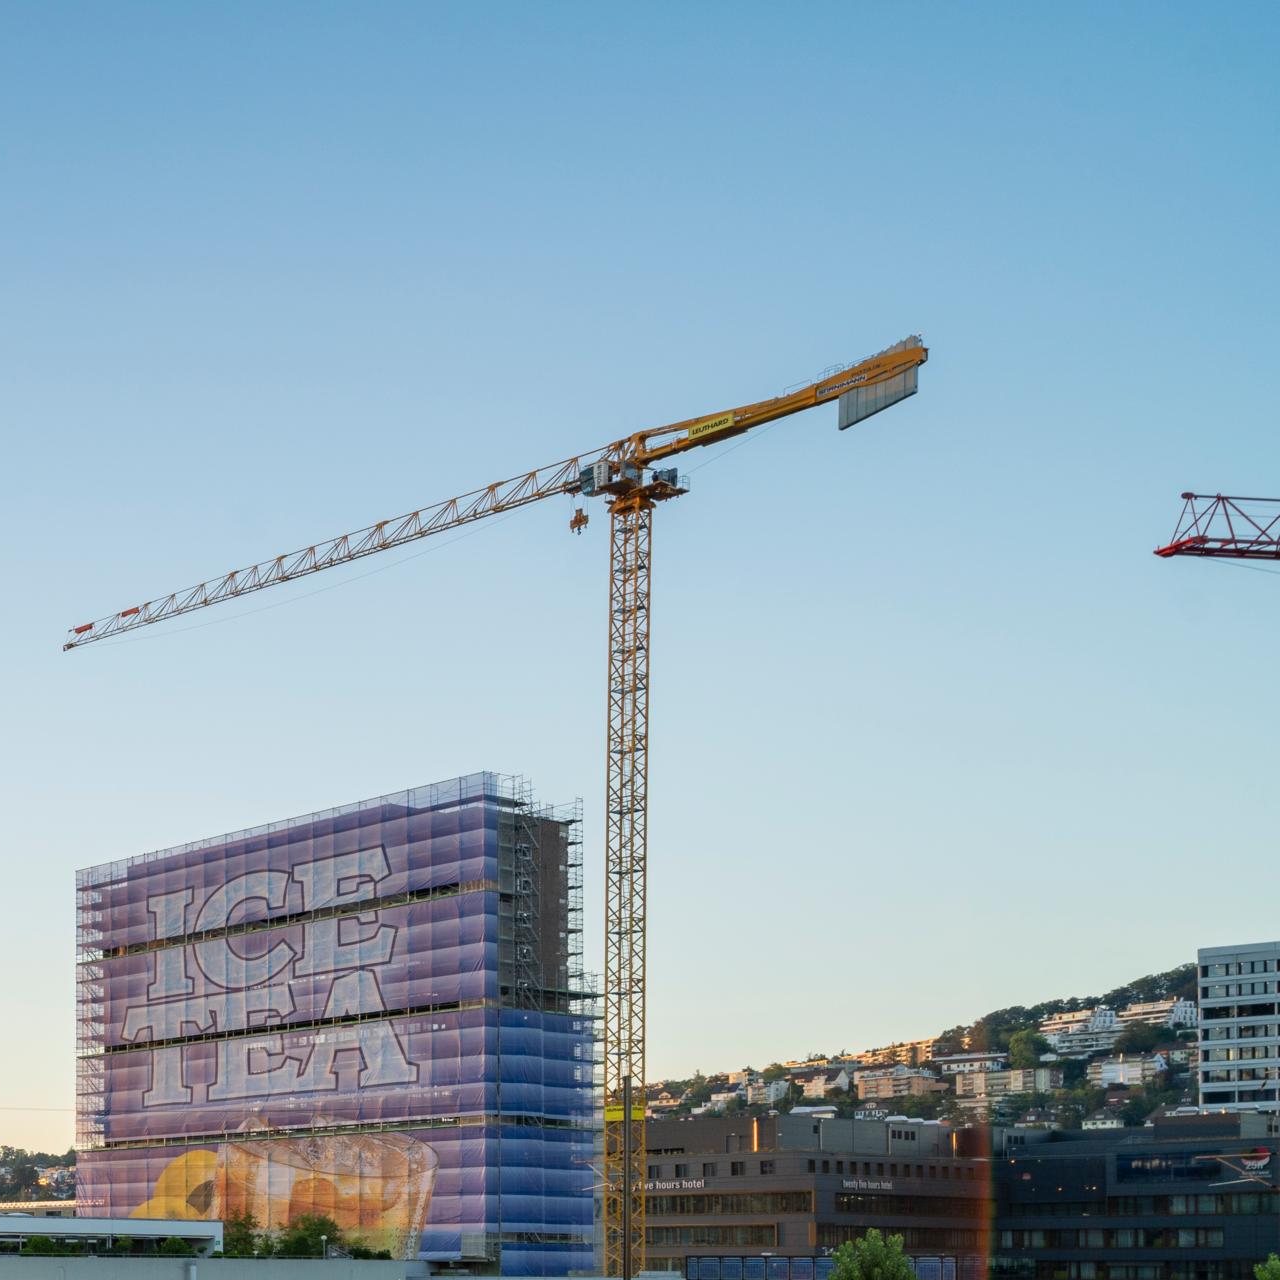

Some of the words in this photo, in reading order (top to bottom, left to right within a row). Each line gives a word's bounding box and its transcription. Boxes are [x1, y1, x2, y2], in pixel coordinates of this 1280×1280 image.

[691, 417, 729, 436] LEUTHARD
[146, 844, 399, 1000] ICE
[120, 967, 419, 1109] TEA
[656, 1181, 680, 1190] hours
[682, 1179, 705, 1189] hotel
